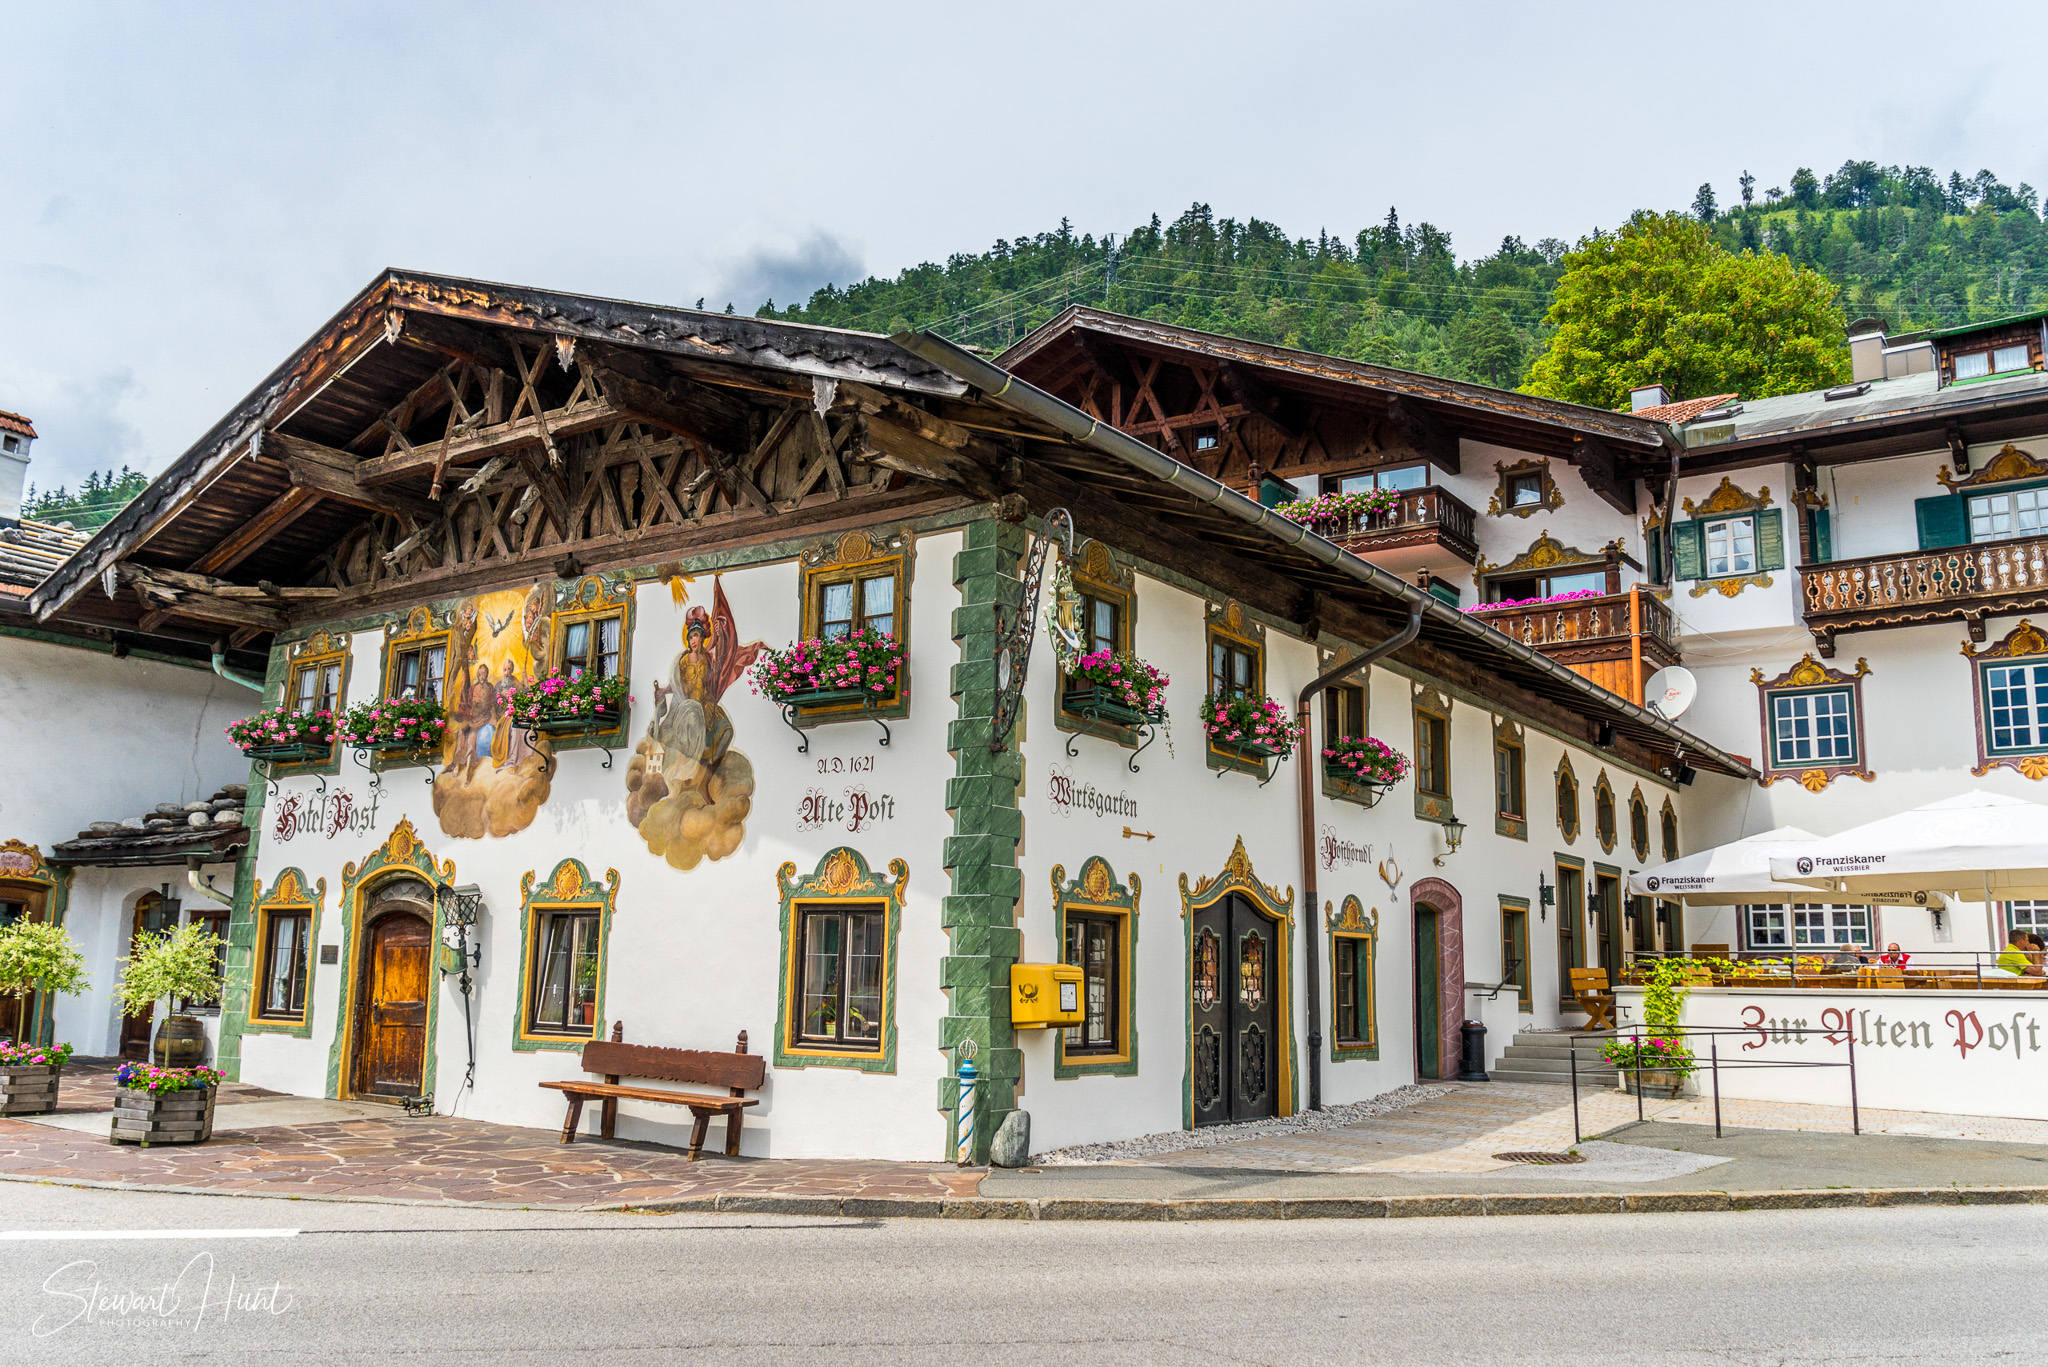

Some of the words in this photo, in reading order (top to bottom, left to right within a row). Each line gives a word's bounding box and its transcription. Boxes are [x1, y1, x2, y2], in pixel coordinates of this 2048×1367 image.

[850, 755, 875, 774] 1621
[1046, 762, 1138, 819] Wirtsgarten
[273, 790, 330, 844] Hotel
[326, 787, 388, 839] Post
[796, 787, 845, 832] Alte
[1816, 855, 1886, 866] Franziskaner
[1833, 864, 1870, 872] WEISSBIER
[1661, 876, 1715, 885] Franziskaner
[1741, 1005, 1808, 1051] Zur
[1821, 1007, 1934, 1049] Alten
